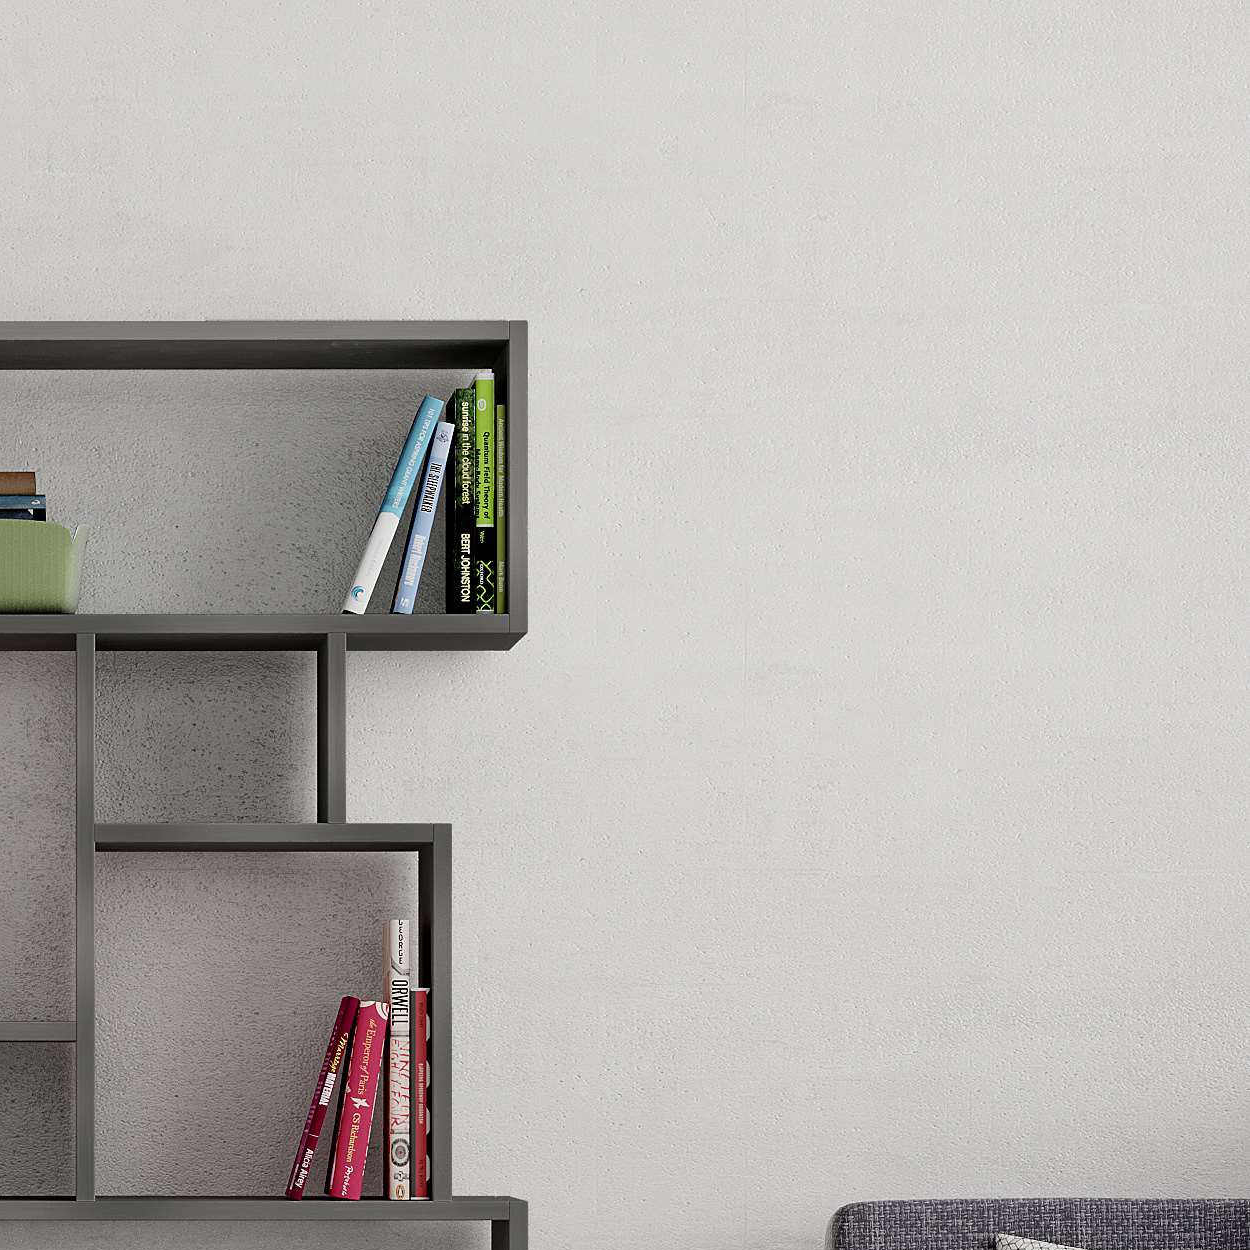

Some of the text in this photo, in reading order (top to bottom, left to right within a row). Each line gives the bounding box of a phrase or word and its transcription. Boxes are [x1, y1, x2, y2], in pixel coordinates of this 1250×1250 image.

[461, 401, 470, 432] sunrise
[462, 442, 470, 455] the
[462, 457, 470, 479] cloud
[421, 462, 442, 513] THE SLEEPWALKER
[462, 480, 470, 504] forest
[482, 485, 490, 509] Theory
[460, 533, 470, 602] BERT JOHNSTON
[392, 979, 408, 1026] ORWELL
[368, 1018, 377, 1029] the
[362, 1028, 375, 1066] Emperor
[319, 1072, 337, 1106] MATERIAL
[357, 1074, 368, 1095] Paris
[346, 1113, 361, 1163] CS Richardson
[304, 1148, 314, 1168] Alicia
